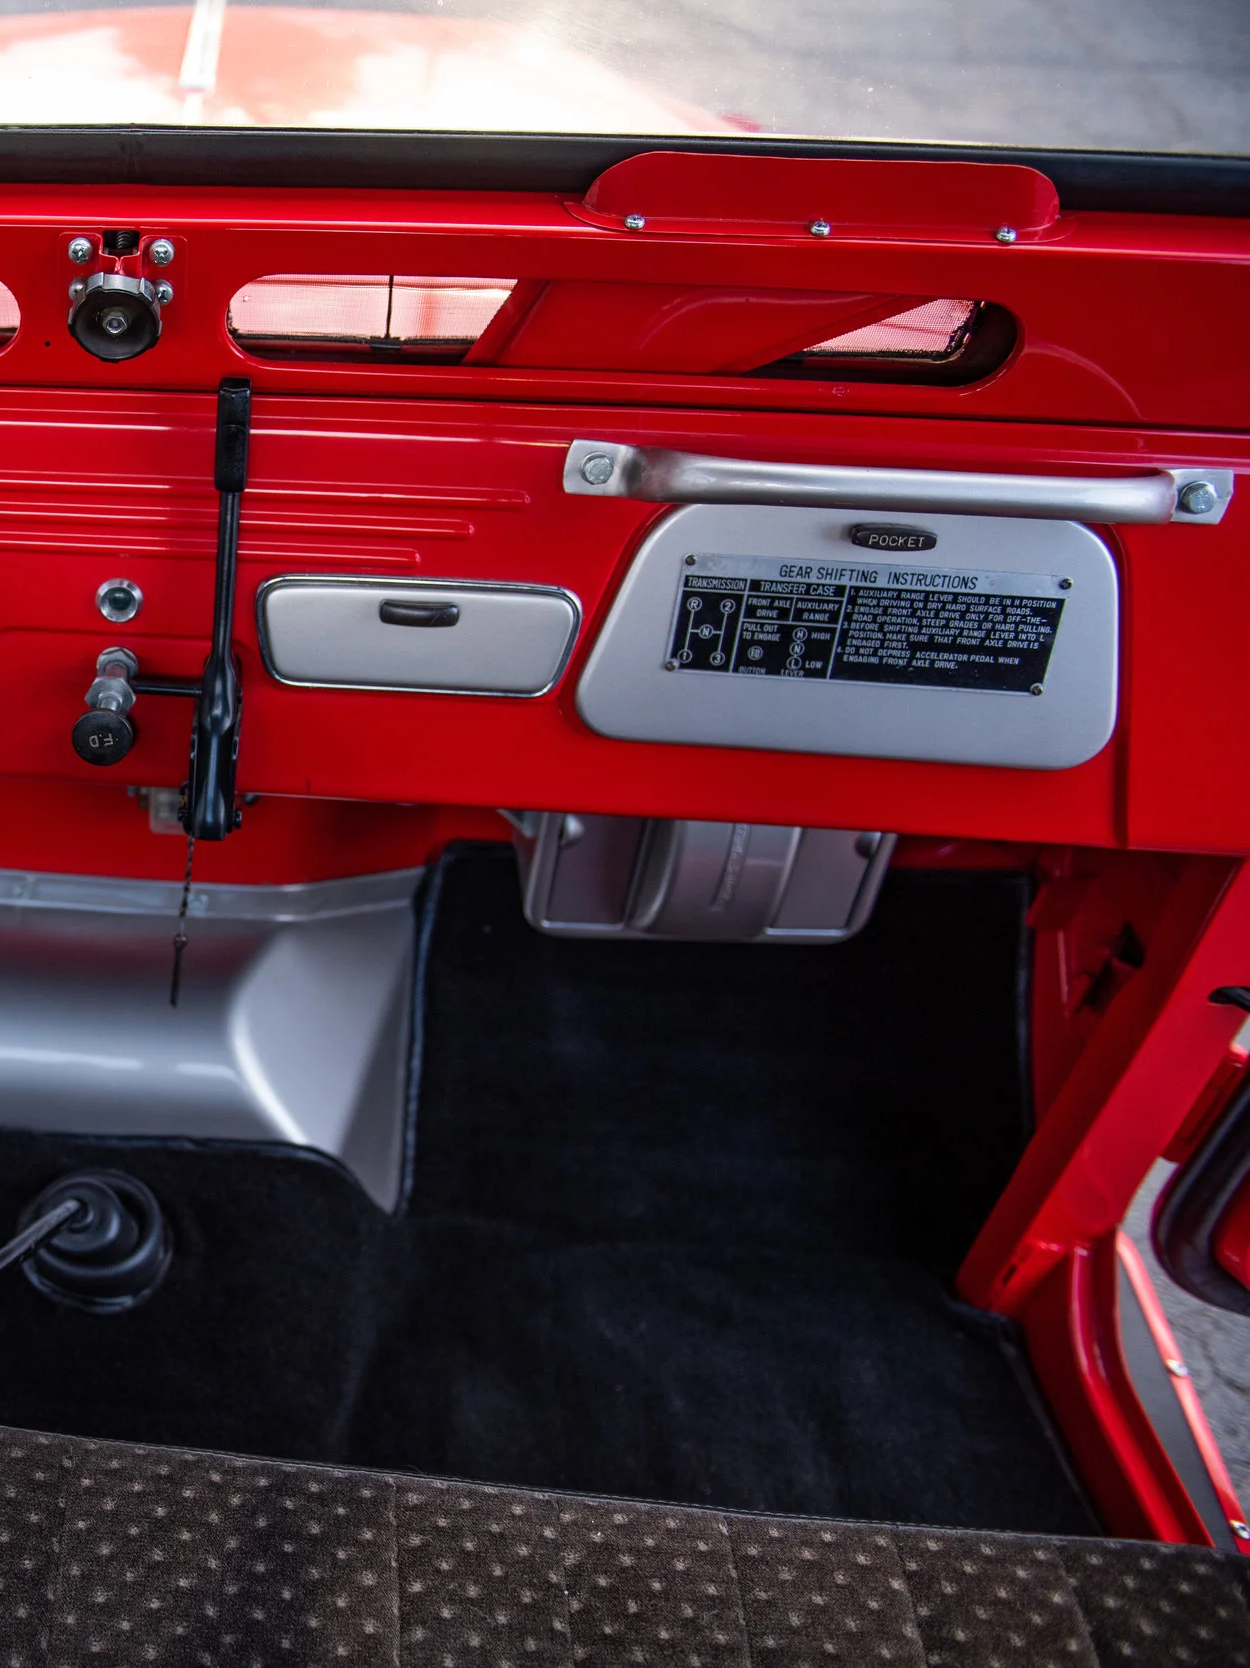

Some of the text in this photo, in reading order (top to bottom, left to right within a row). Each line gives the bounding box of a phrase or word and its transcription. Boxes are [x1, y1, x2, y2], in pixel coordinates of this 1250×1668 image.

[868, 534, 926, 548] POCKET
[779, 564, 979, 590] GEAR SHIFTING INSTRUCTIONS
[687, 577, 747, 590] TRANSMISSION
[760, 581, 836, 597] TRANSFER CASE
[690, 600, 699, 609] R
[748, 597, 791, 609] FRONT AXLE
[858, 589, 898, 599] AUXILIARY
[900, 592, 926, 600] RANGE
[929, 593, 954, 602] LEVER
[957, 595, 986, 604] SHOULD
[989, 597, 1001, 605] BE
[1003, 598, 1012, 606] IN
[1022, 599, 1058, 609] POSITION
[724, 602, 732, 611] 2
[796, 600, 840, 611] AUXILIARY
[857, 597, 1033, 616] WHEN DRIVING ON DRY HARD SURFACE ROADS.
[756, 609, 779, 618] DRIVE
[802, 612, 830, 621] RANGE
[854, 606, 884, 615] ENGAGE
[887, 607, 913, 616] FRONT
[915, 610, 936, 618] AXLE
[939, 611, 961, 620] DRIVE
[965, 612, 986, 621] ONLY
[988, 614, 1005, 622] FOR
[742, 622, 779, 633] PULL OUT
[852, 613, 873, 622] ROAD
[921, 618, 947, 627] STEEP
[949, 620, 979, 630] GRADES
[981, 622, 993, 630] OR
[995, 623, 1016, 631] HARD
[701, 627, 711, 637] N
[742, 631, 781, 642] TO ENGAGE
[796, 630, 831, 641] H HIGH
[850, 621, 880, 631] BEFORE
[883, 624, 919, 634] SHIFTING
[921, 627, 961, 636] AUXILIARY
[962, 629, 987, 638] RANGE
[990, 631, 1016, 640] LEVER
[1018, 633, 1037, 641] INTO
[1039, 634, 1046, 642] L
[846, 638, 909, 649] ENGAGED FIRST.
[885, 632, 908, 641] MAKE
[909, 634, 930, 643] SURE
[933, 636, 954, 644] THAT
[956, 637, 982, 646] FRONT
[983, 639, 1004, 648] AXLE
[1006, 640, 1028, 649] DRIVE
[793, 644, 802, 654] N
[713, 654, 722, 664] 3
[844, 646, 856, 655] DO
[858, 647, 875, 656] NOT
[877, 648, 911, 658] DEPRESS
[915, 651, 969, 661] ACCELERATOR
[970, 655, 995, 663] PEDAL
[997, 656, 1021, 665] WHEN
[790, 659, 824, 669] L LOW
[843, 654, 959, 670] ENGAGING FRONT AXLE DRIVE.
[780, 668, 805, 677] LEVER
